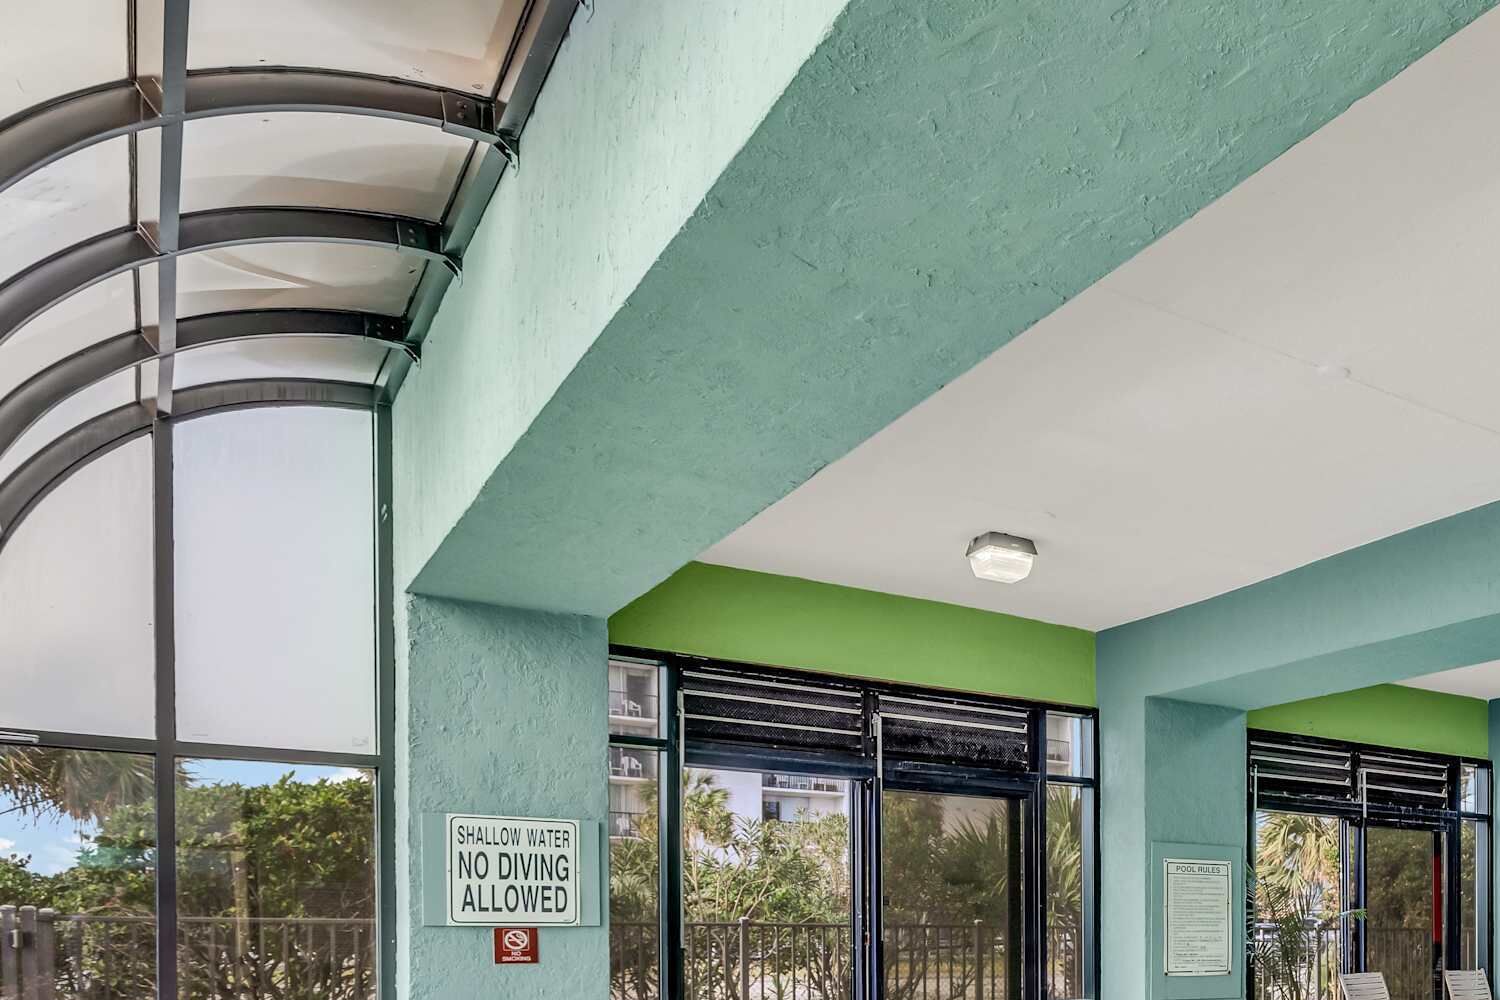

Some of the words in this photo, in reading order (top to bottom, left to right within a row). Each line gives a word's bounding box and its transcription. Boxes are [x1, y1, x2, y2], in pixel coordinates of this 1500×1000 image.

[457, 825, 521, 846] SHALLOW
[527, 828, 570, 848] WATER
[459, 851, 489, 880] NO
[499, 852, 569, 881] DIVING
[461, 884, 568, 913] ALLOWED
